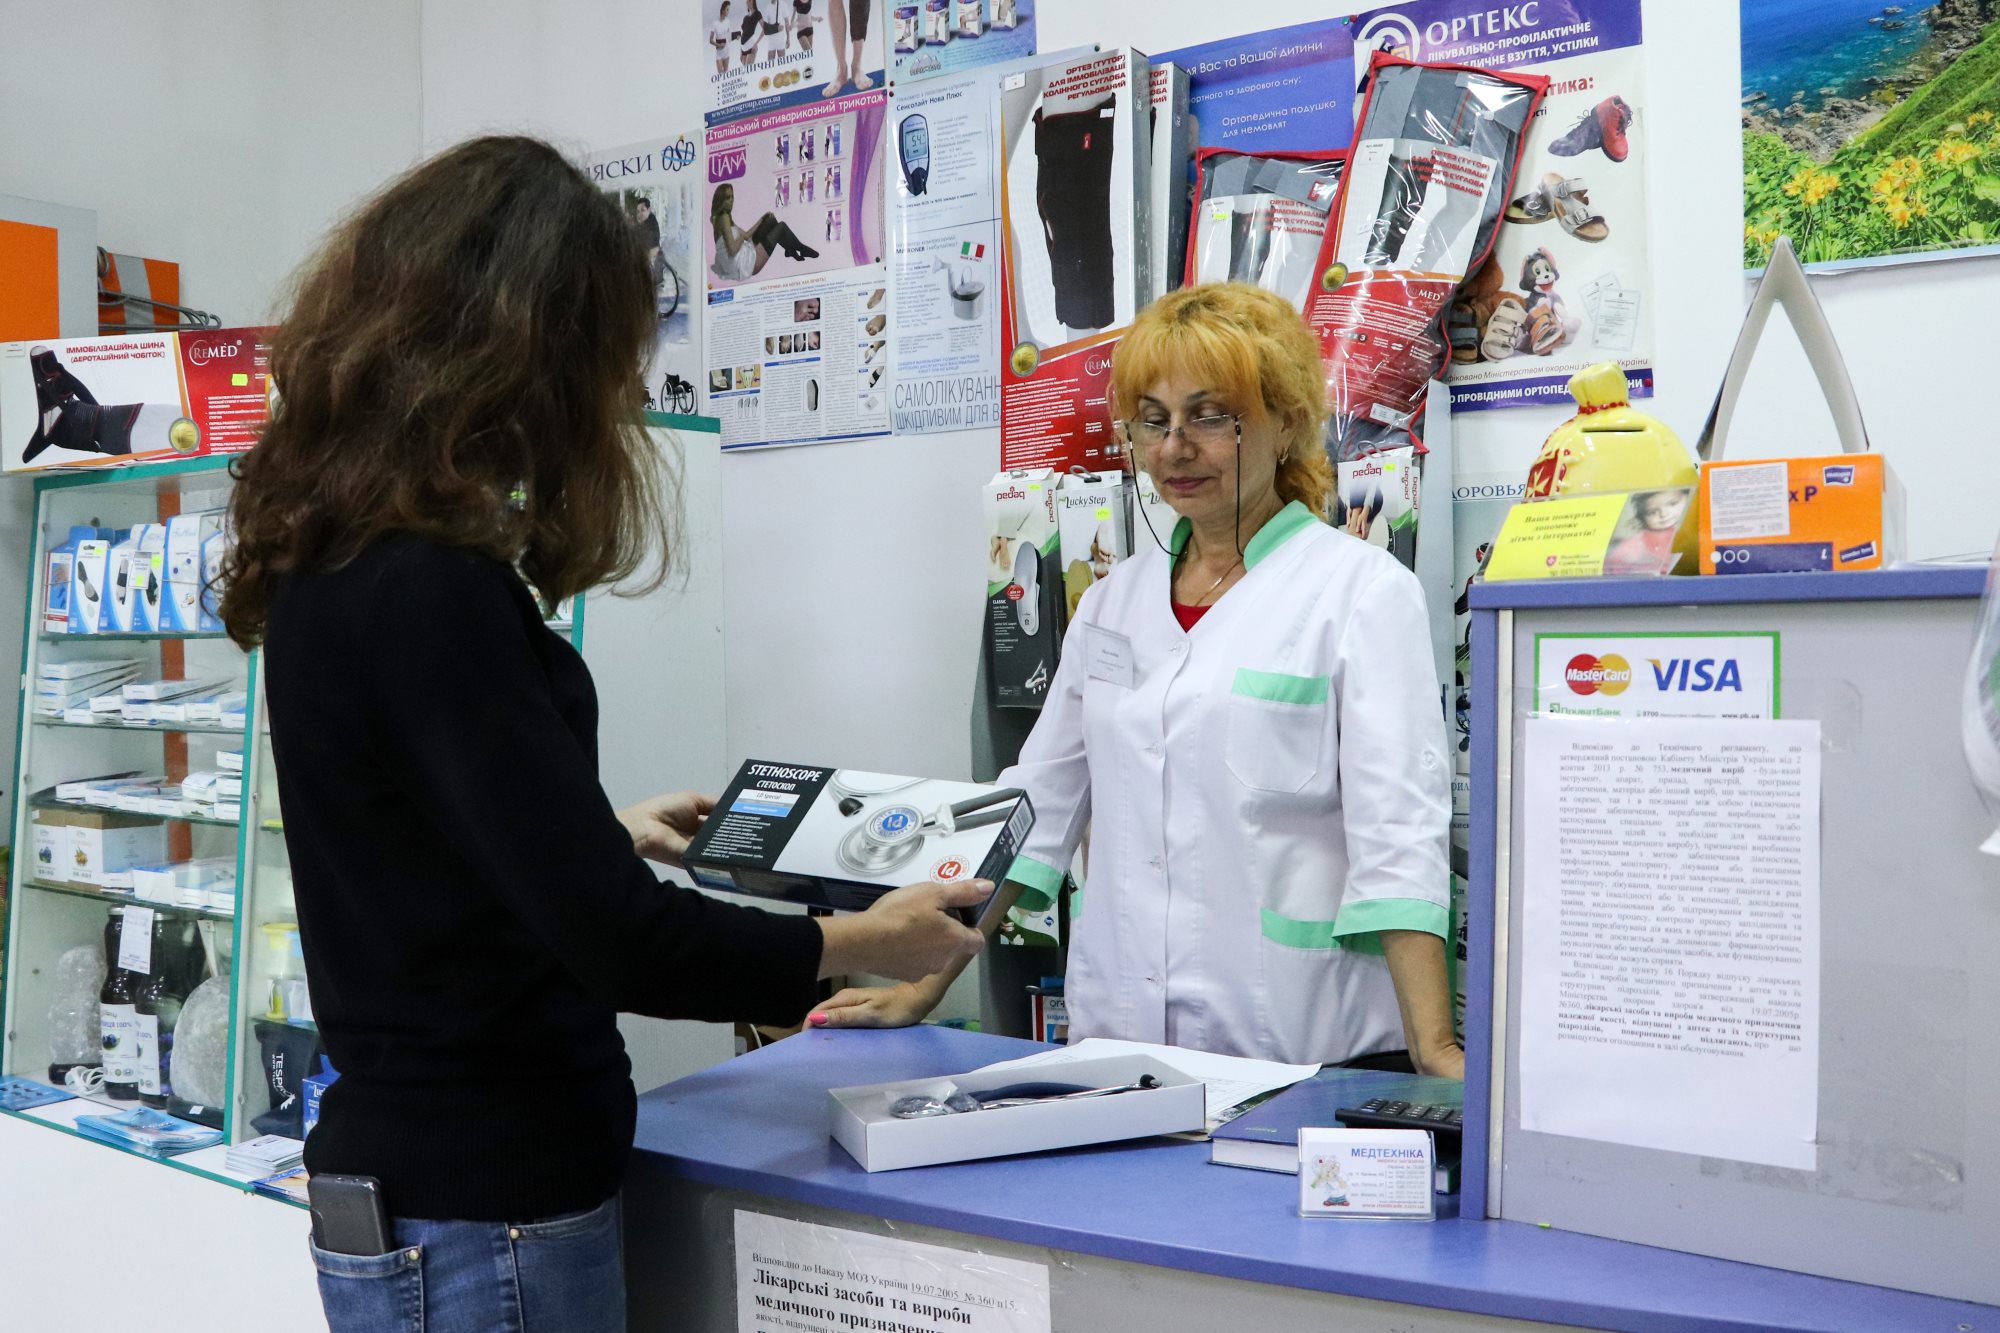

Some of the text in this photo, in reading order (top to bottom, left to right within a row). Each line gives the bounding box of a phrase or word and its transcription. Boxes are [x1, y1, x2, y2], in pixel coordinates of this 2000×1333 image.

[1425, 1, 1540, 46] ОРТЕКС
[1428, 22, 1591, 62] ЛІКУВАЛЬНО-ПРОФІЛАКТИЧНЕ
[1508, 36, 1599, 63] ВЗУТТЯ, УСТІЛКИ
[711, 49, 814, 83] ОРТОПЕДИЧНІ ВИРОБИ
[1066, 54, 1126, 75] ОРТЕЗ (ТУТОР)
[1200, 60, 1221, 75] Вас
[1224, 58, 1237, 69] та
[1240, 50, 1278, 66] Вашої
[1279, 41, 1324, 58] дитини
[1043, 72, 1126, 99] КОЛІННОГО СУГЛОБА
[1048, 78, 1066, 89] ДЛЯ
[1067, 80, 1126, 101] РЕГУЛЬОВАНИЙ
[1226, 88, 1234, 97] та
[1237, 81, 1281, 95] здорового
[896, 91, 963, 112] Сенсолайт Нова Плюс
[708, 117, 760, 142] Італійський
[762, 104, 836, 129] антиварикозний
[838, 93, 885, 114] трикотаж
[1222, 100, 1337, 127] Ортопедична подушка
[1222, 120, 1287, 139] для немовлят
[66, 341, 165, 354] ІММОБІЛІЗАЦІЙНА ШИНА
[130, 351, 166, 360] ЧОБІТОК)
[1484, 366, 1544, 380] Міністерством
[1545, 363, 1580, 374] охорони
[1457, 388, 1523, 403] ПРОВІДНИМИ
[895, 406, 961, 432] ШКІДЛИВИМ
[966, 404, 989, 427] ДЛЯ
[1066, 495, 1107, 509] Lucky Step
[1566, 658, 1743, 693] MasterCard VISA
[1572, 742, 1613, 752] Відповідно
[1630, 744, 1640, 752] до
[1658, 744, 1703, 752] Технічного
[747, 764, 823, 782] STETHOSCOPE
[1721, 766, 1745, 775] виріб
[756, 780, 797, 792] СТЕТОСКОП
[1558, 1012, 1595, 1021] належної
[1745, 1031, 1802, 1042] структурних
[1584, 1003, 1622, 1013] лікарські
[1624, 1006, 1650, 1016] засоби
[1664, 1011, 1694, 1021] вироби
[1696, 1014, 1742, 1024] медичного
[1744, 1019, 1802, 1030] призначення
[1351, 1148, 1424, 1159] МЕДТЕХНІКА
[752, 1252, 800, 1271] Відповідно
[801, 1264, 813, 1273] до
[814, 1264, 845, 1281] Наказу
[847, 1270, 869, 1284] МОЗ
[870, 1277, 908, 1292] України
[910, 1282, 959, 1300] 19.07.2005
[964, 1292, 975, 1302] №
[977, 1294, 995, 1307] 360
[753, 1268, 972, 1325] Лікарські засоби та вироби
[755, 1295, 835, 1322] медичного
[755, 1313, 784, 1326] якості,
